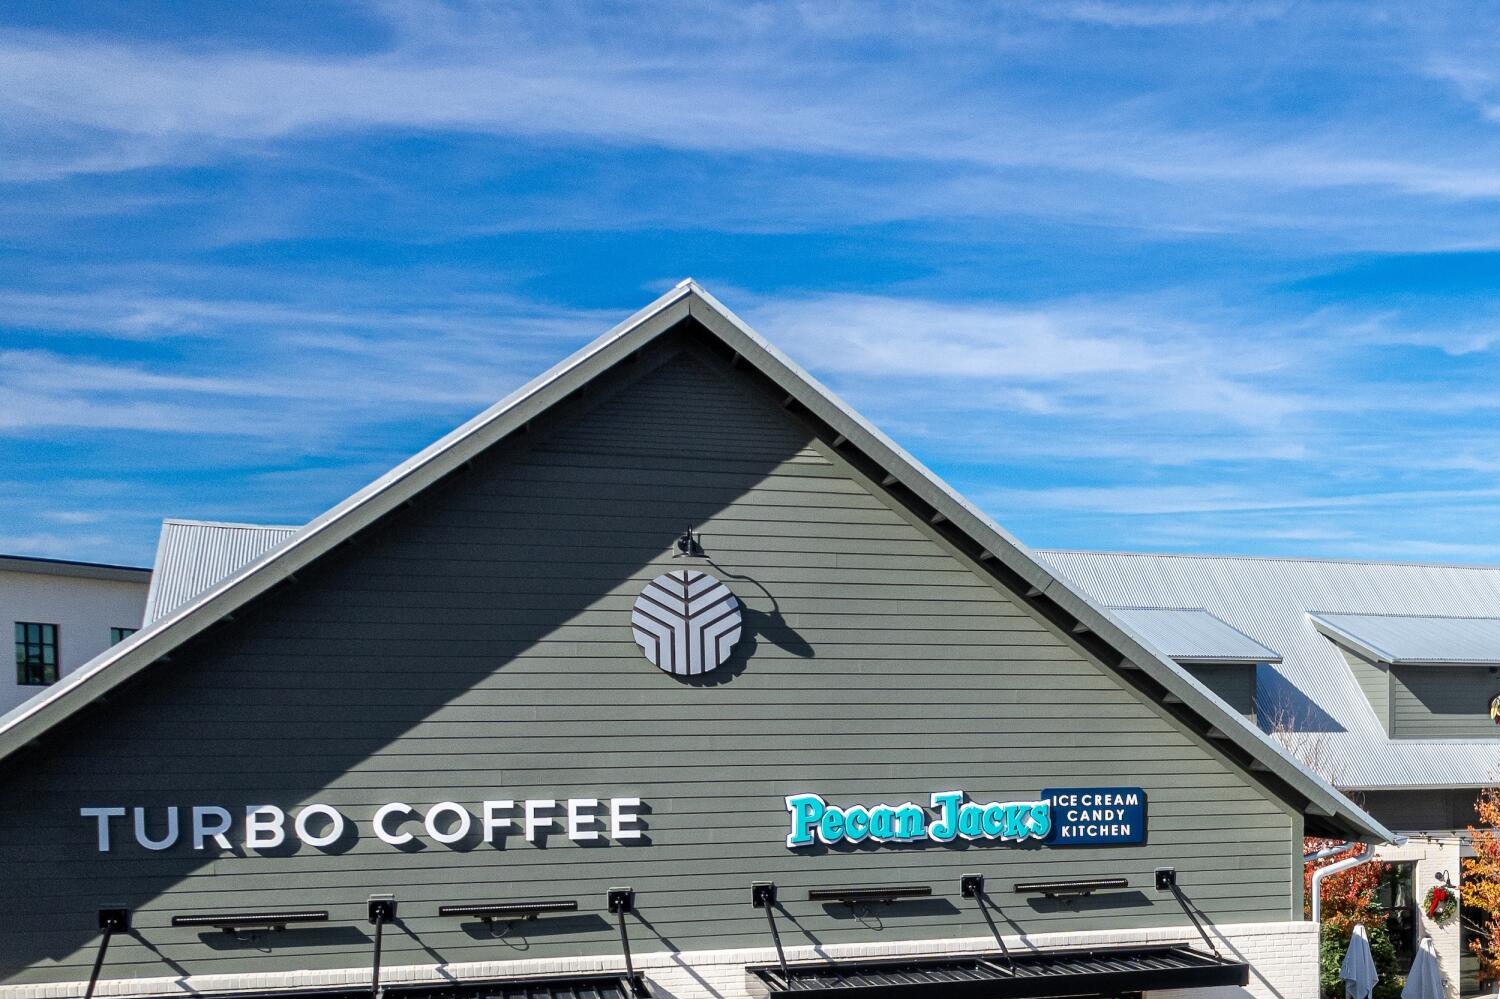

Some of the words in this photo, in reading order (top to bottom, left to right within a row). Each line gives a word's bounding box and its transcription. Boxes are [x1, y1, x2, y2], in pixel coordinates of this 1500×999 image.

[1053, 795, 1078, 807] ICE
[1081, 794, 1139, 806] CREAM
[787, 793, 927, 847] Pecan
[929, 790, 1051, 842] Jacks
[1066, 809, 1125, 822] CANDY
[80, 803, 344, 851] TURBO
[373, 797, 641, 845] COFFEE
[1061, 824, 1131, 838] KITCHEN
